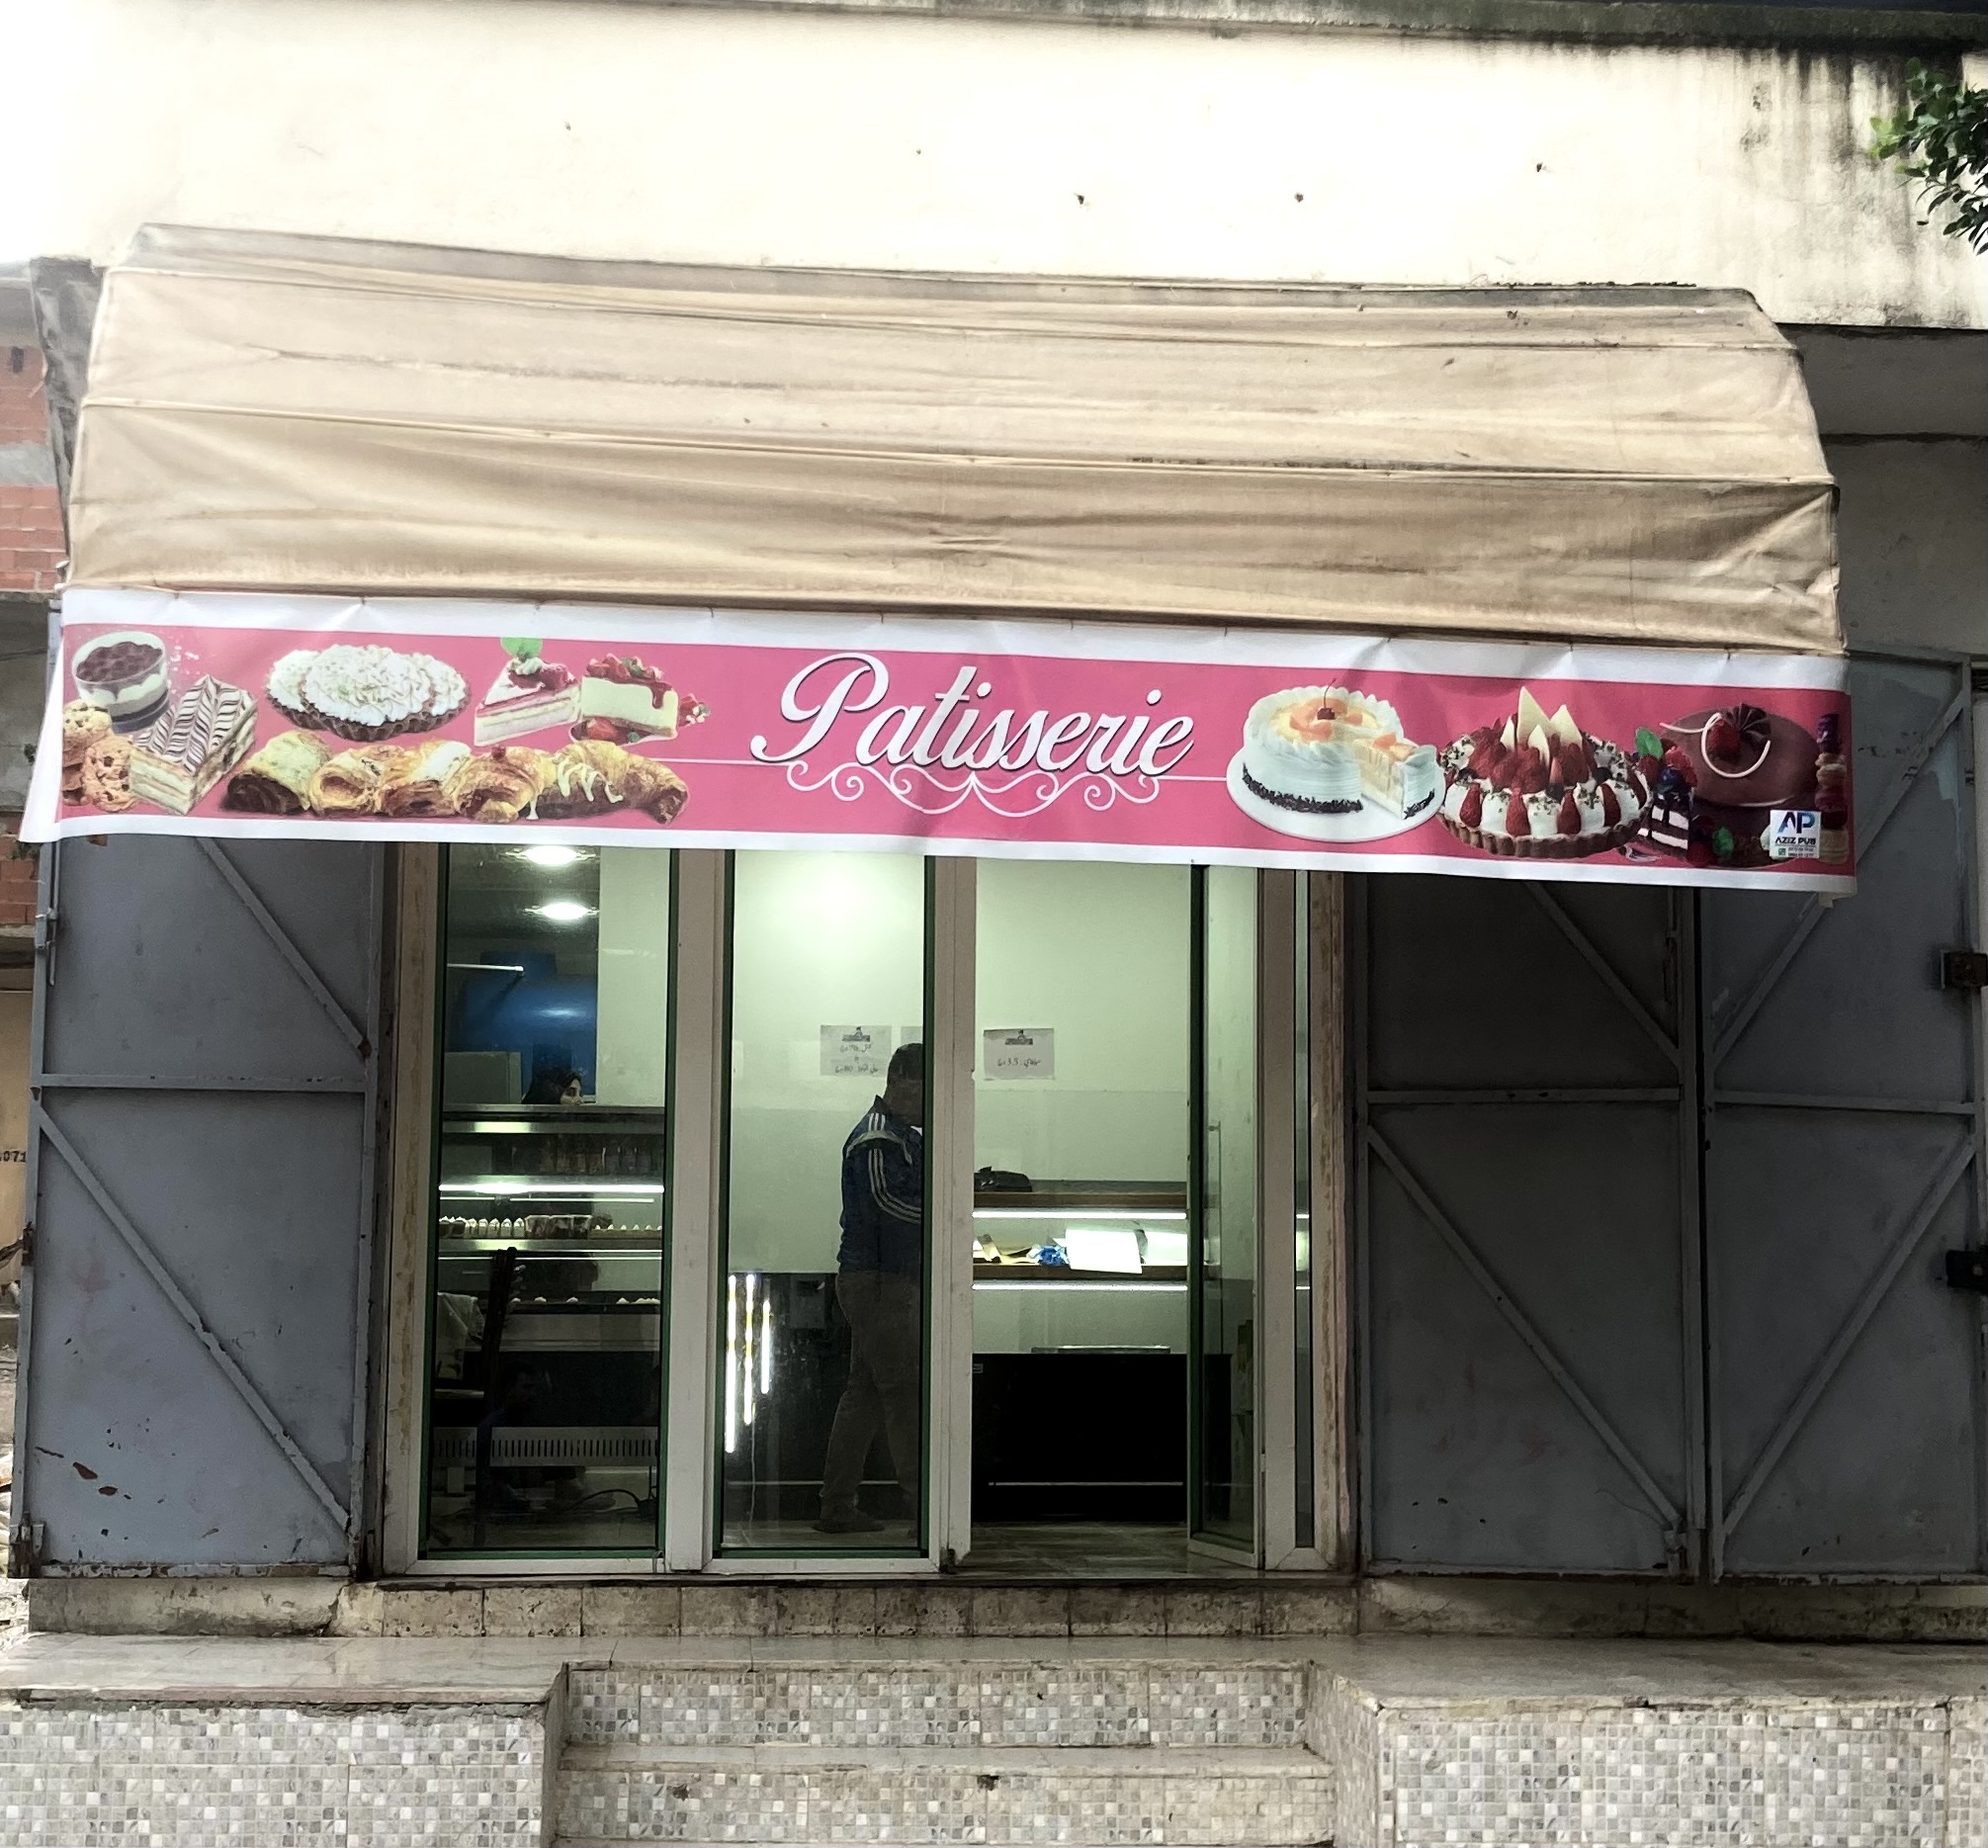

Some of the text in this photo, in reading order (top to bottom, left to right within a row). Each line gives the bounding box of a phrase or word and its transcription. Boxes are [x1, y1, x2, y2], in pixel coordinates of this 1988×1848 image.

[749, 652, 1194, 776] Patisserie
[1777, 811, 1816, 834] AP
[1798, 836, 1816, 845] PUB
[0, 1150, 27, 1163] 071
